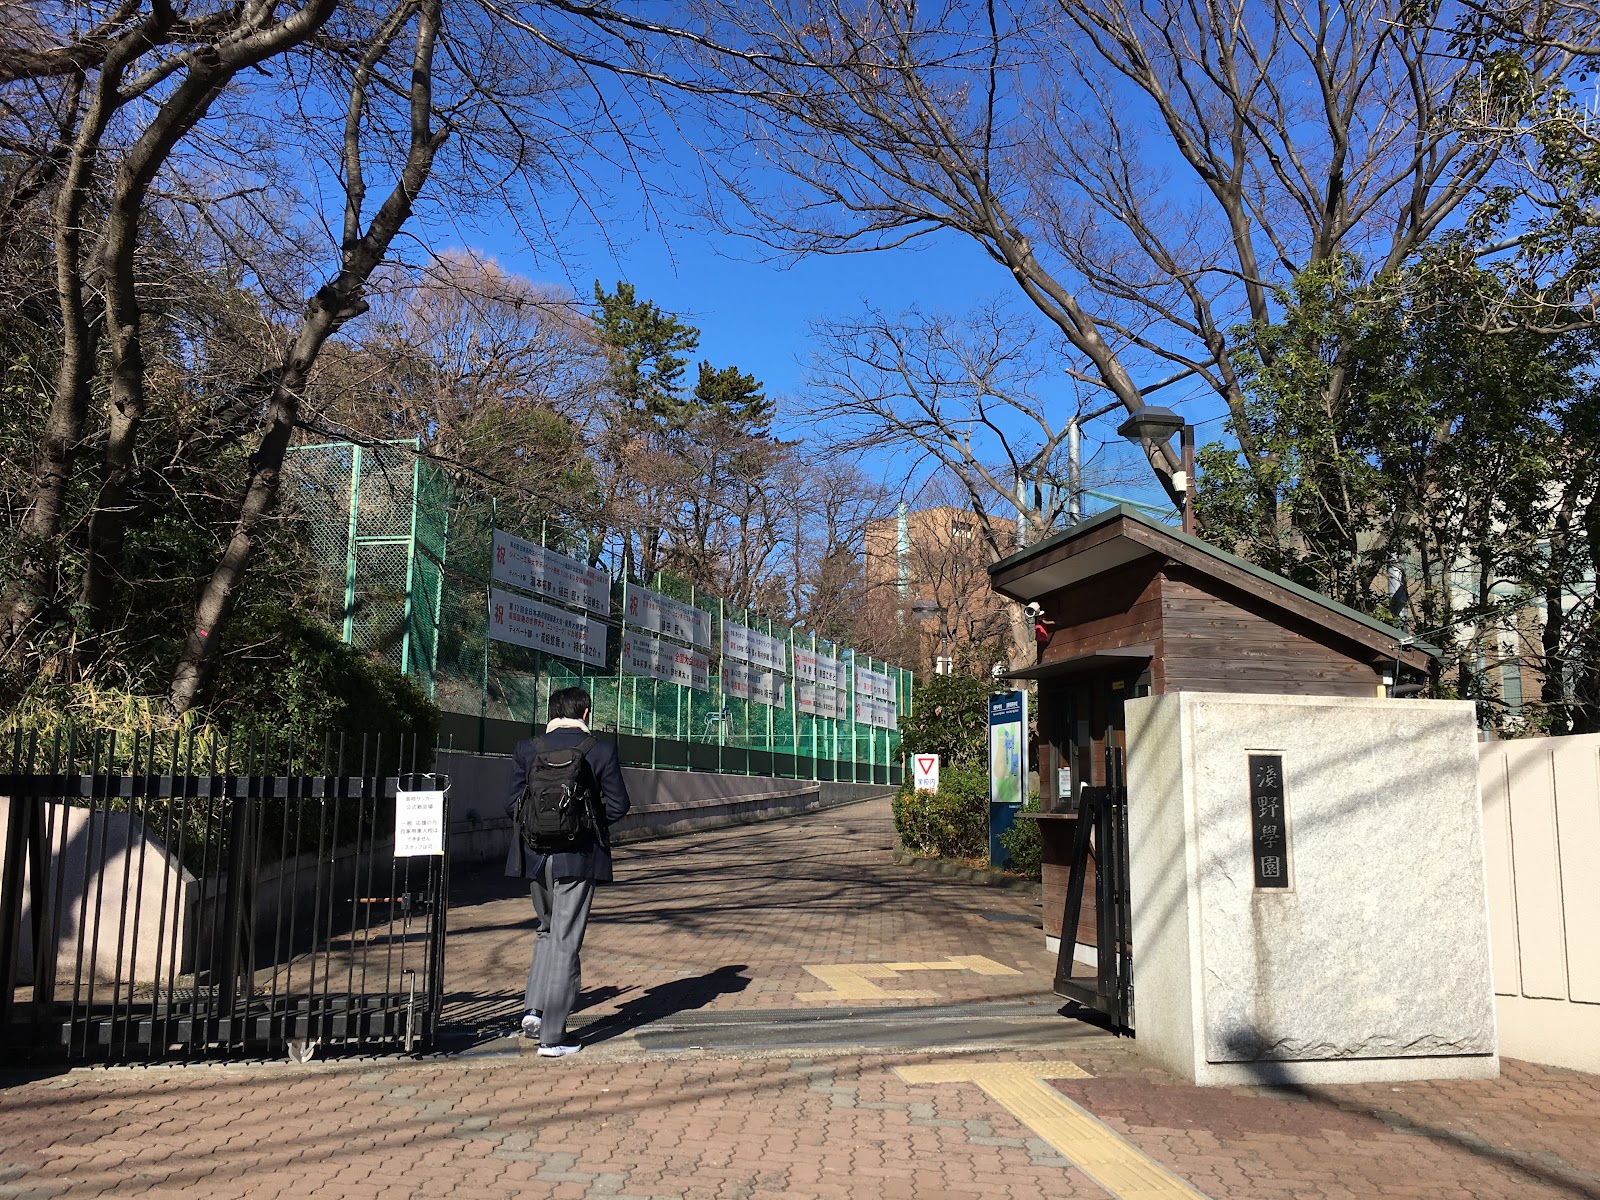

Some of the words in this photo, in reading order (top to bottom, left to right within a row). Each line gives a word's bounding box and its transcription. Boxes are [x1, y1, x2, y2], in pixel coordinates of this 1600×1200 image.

[496, 545, 505, 565] 祝
[494, 603, 504, 624] 祝
[629, 594, 639, 617] 祝
[623, 640, 630, 658] 祝
[918, 778, 936, 787] 学校内
